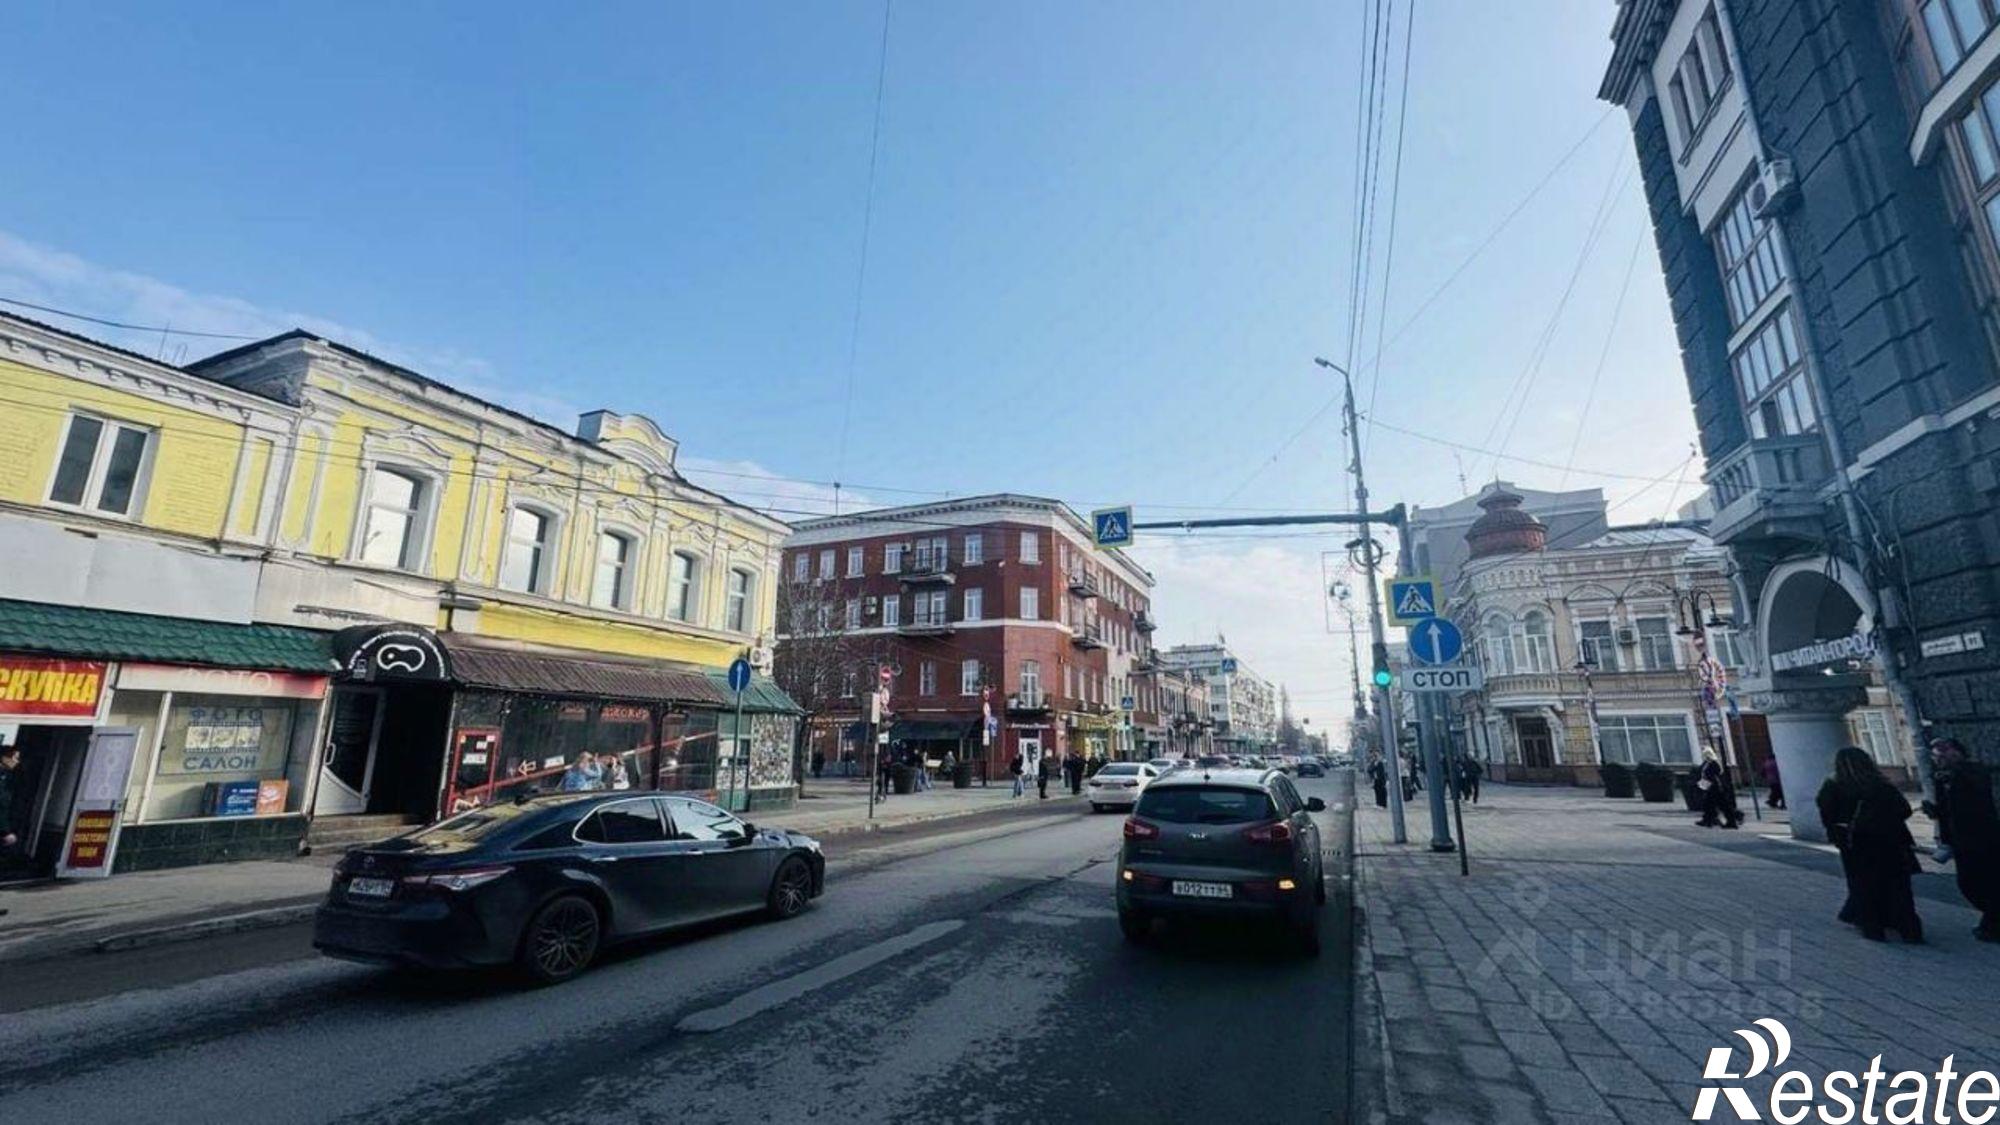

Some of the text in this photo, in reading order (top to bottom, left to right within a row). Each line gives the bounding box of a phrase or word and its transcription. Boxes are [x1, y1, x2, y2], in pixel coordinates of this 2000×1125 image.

[1412, 670, 1471, 688] СТОП
[190, 707, 263, 721] ФОТО
[183, 755, 257, 770] САЛОН
